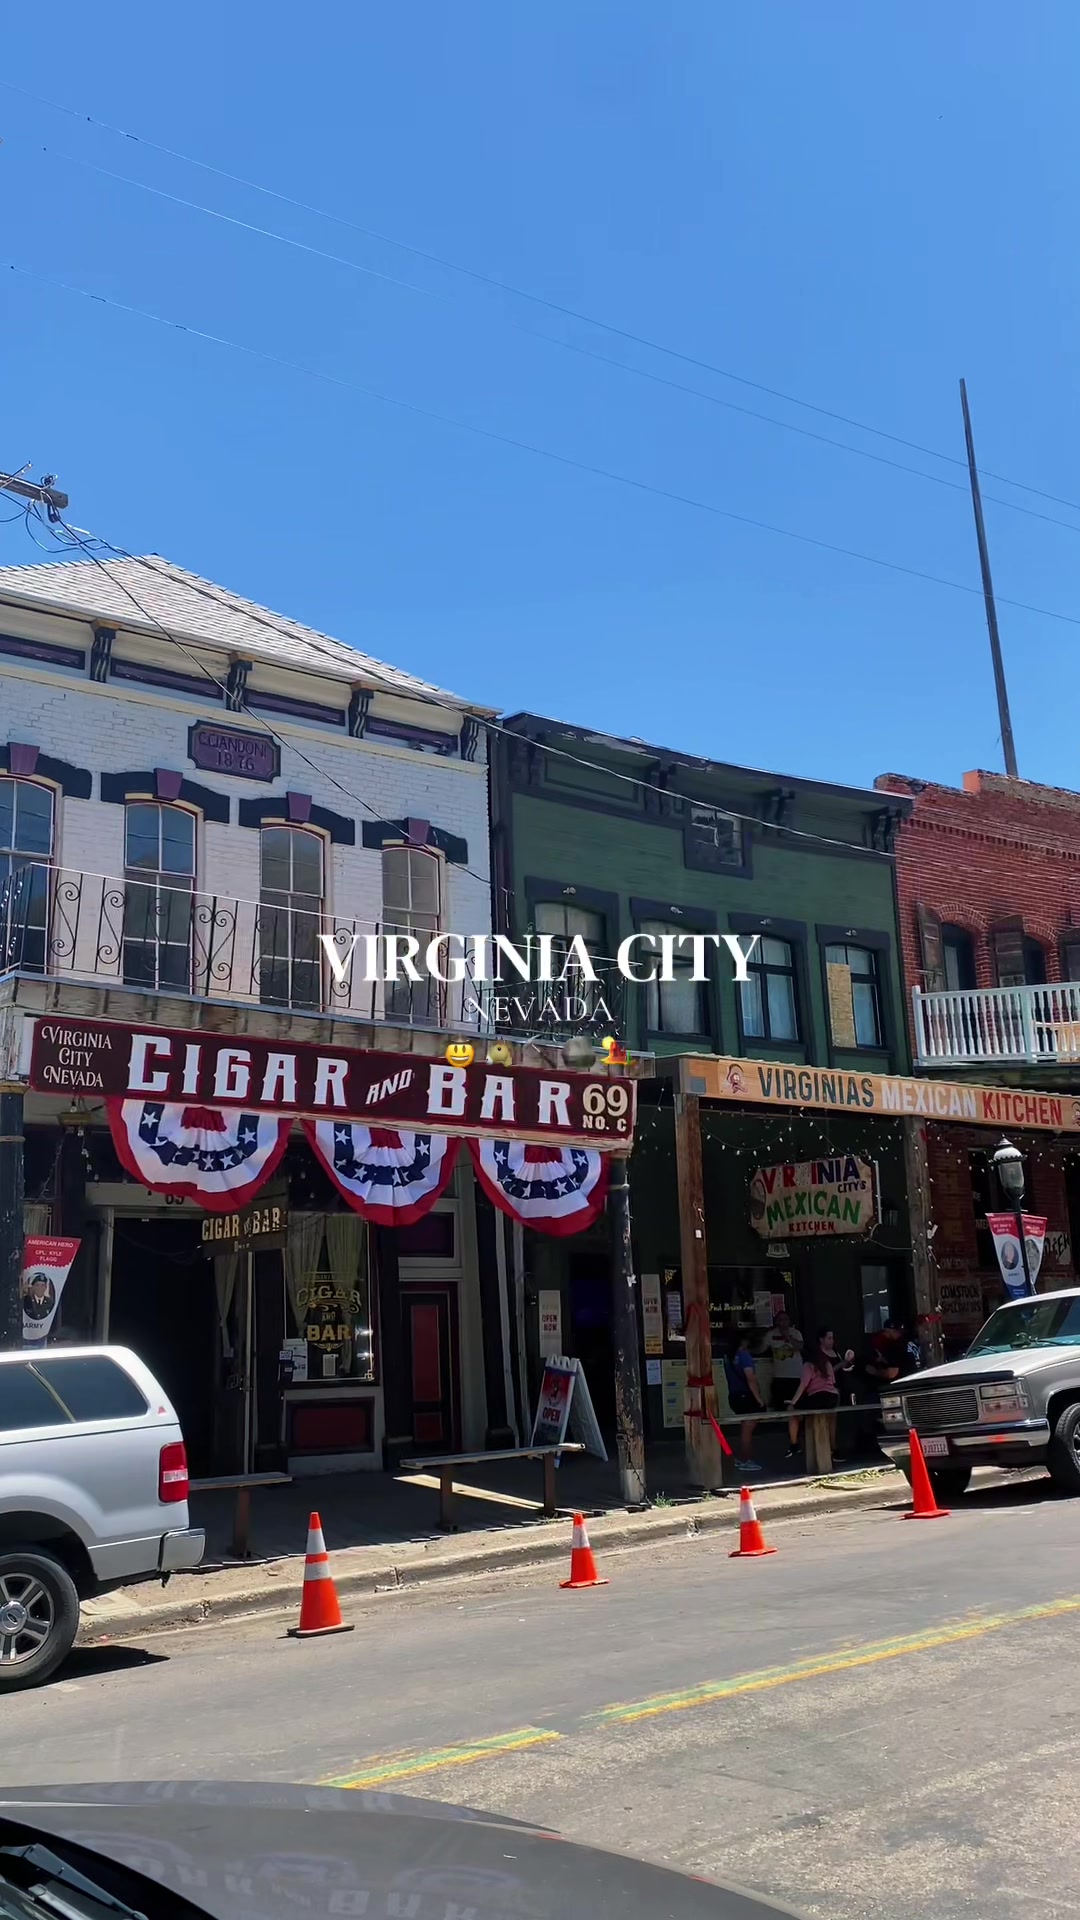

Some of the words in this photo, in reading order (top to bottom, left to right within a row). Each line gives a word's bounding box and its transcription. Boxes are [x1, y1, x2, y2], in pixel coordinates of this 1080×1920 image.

[41, 1025, 112, 1050] VIRGINIA
[59, 1047, 93, 1068] CITY
[43, 1065, 105, 1088] NEVADA
[127, 1033, 350, 1108] CIGAR
[365, 1068, 414, 1105] AND
[426, 1063, 572, 1127] BAR
[582, 1083, 629, 1117] 69
[757, 1066, 875, 1108] VIRGINIAS
[880, 1080, 978, 1119] MEXICAN
[981, 1090, 1064, 1126] KITCHEN
[582, 1114, 610, 1131] NO.
[616, 1118, 628, 1133] C
[761, 1157, 861, 1195] VRINIA
[766, 1190, 861, 1230] MEXICAN
[201, 1214, 240, 1241] CIGAR
[252, 1207, 281, 1235] BAR
[788, 1220, 835, 1233] KITCHEN
[27, 1239, 57, 1247] AMERICAN
[57, 1240, 74, 1249] HERO
[296, 1284, 362, 1308] CIGAR
[541, 1314, 558, 1322] OPEN
[306, 1324, 353, 1341] BAR
[543, 1407, 561, 1422] OPEN
